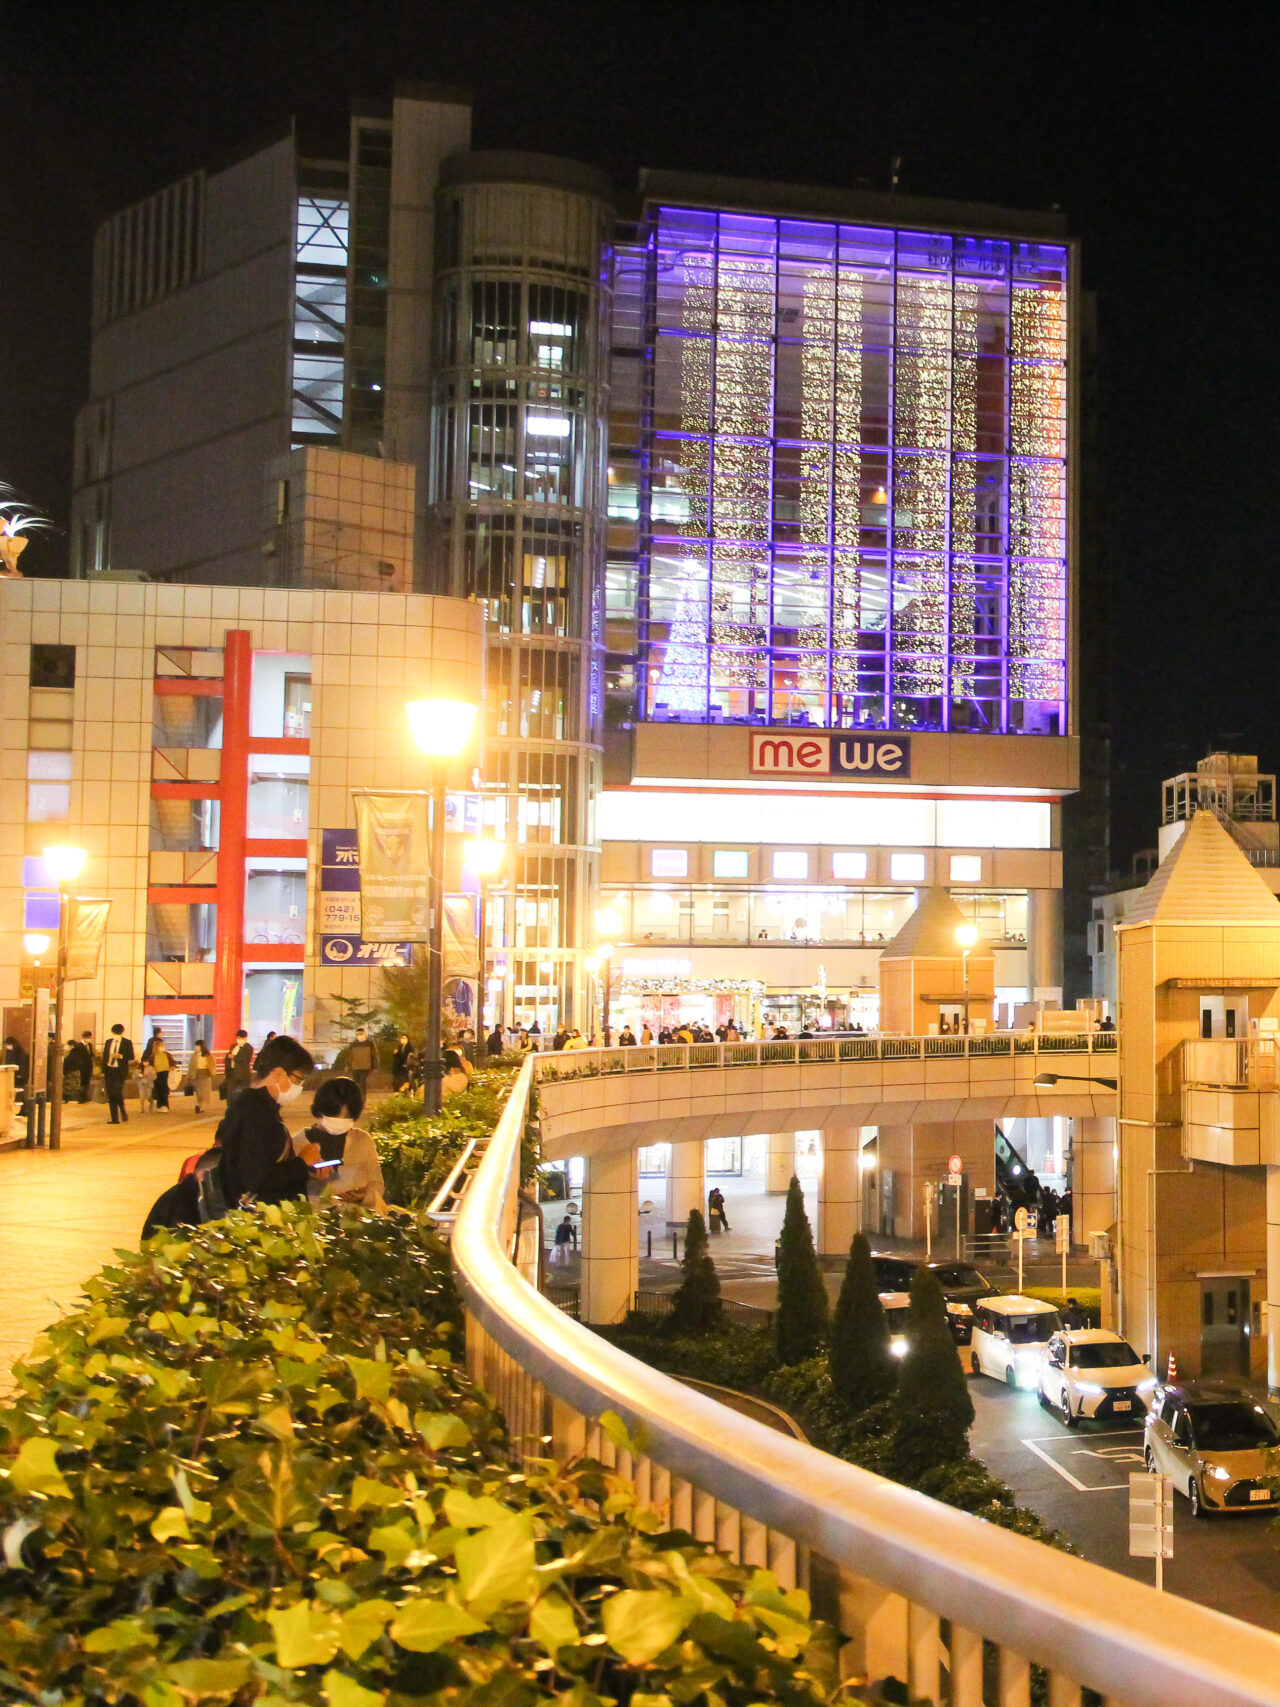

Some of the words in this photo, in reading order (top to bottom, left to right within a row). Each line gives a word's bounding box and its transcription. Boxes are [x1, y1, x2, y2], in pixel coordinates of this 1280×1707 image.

[759, 740, 822, 768] me
[839, 741, 904, 771] we
[324, 905, 355, 913] (042)
